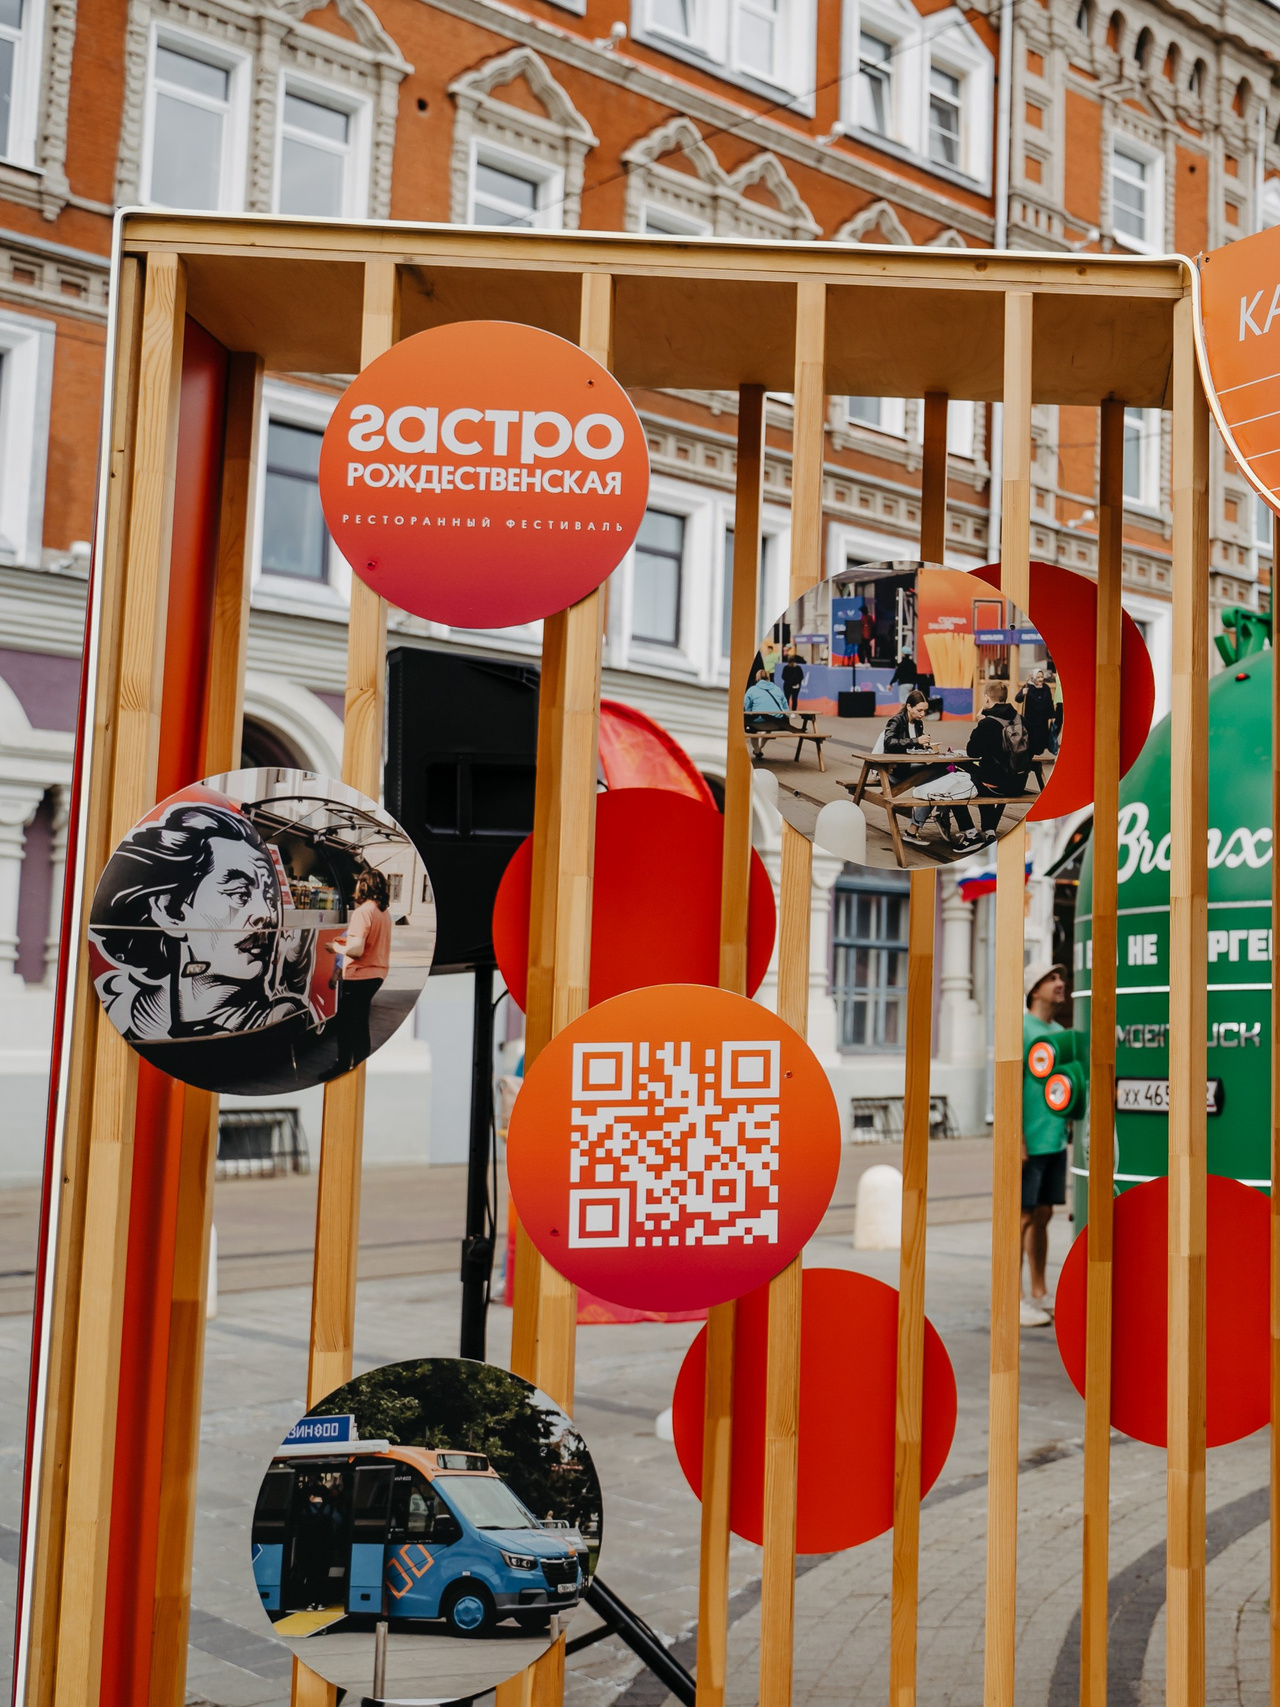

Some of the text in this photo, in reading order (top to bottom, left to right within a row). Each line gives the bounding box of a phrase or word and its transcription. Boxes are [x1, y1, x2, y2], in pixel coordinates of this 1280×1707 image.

[347, 462, 622, 495] РОЖДЕСТВЕНСКАЯ
[342, 514, 623, 532] РЕСТОРАННЫЙ ФЕСТИВАЛЬ
[1127, 933, 1159, 966] НЕ
